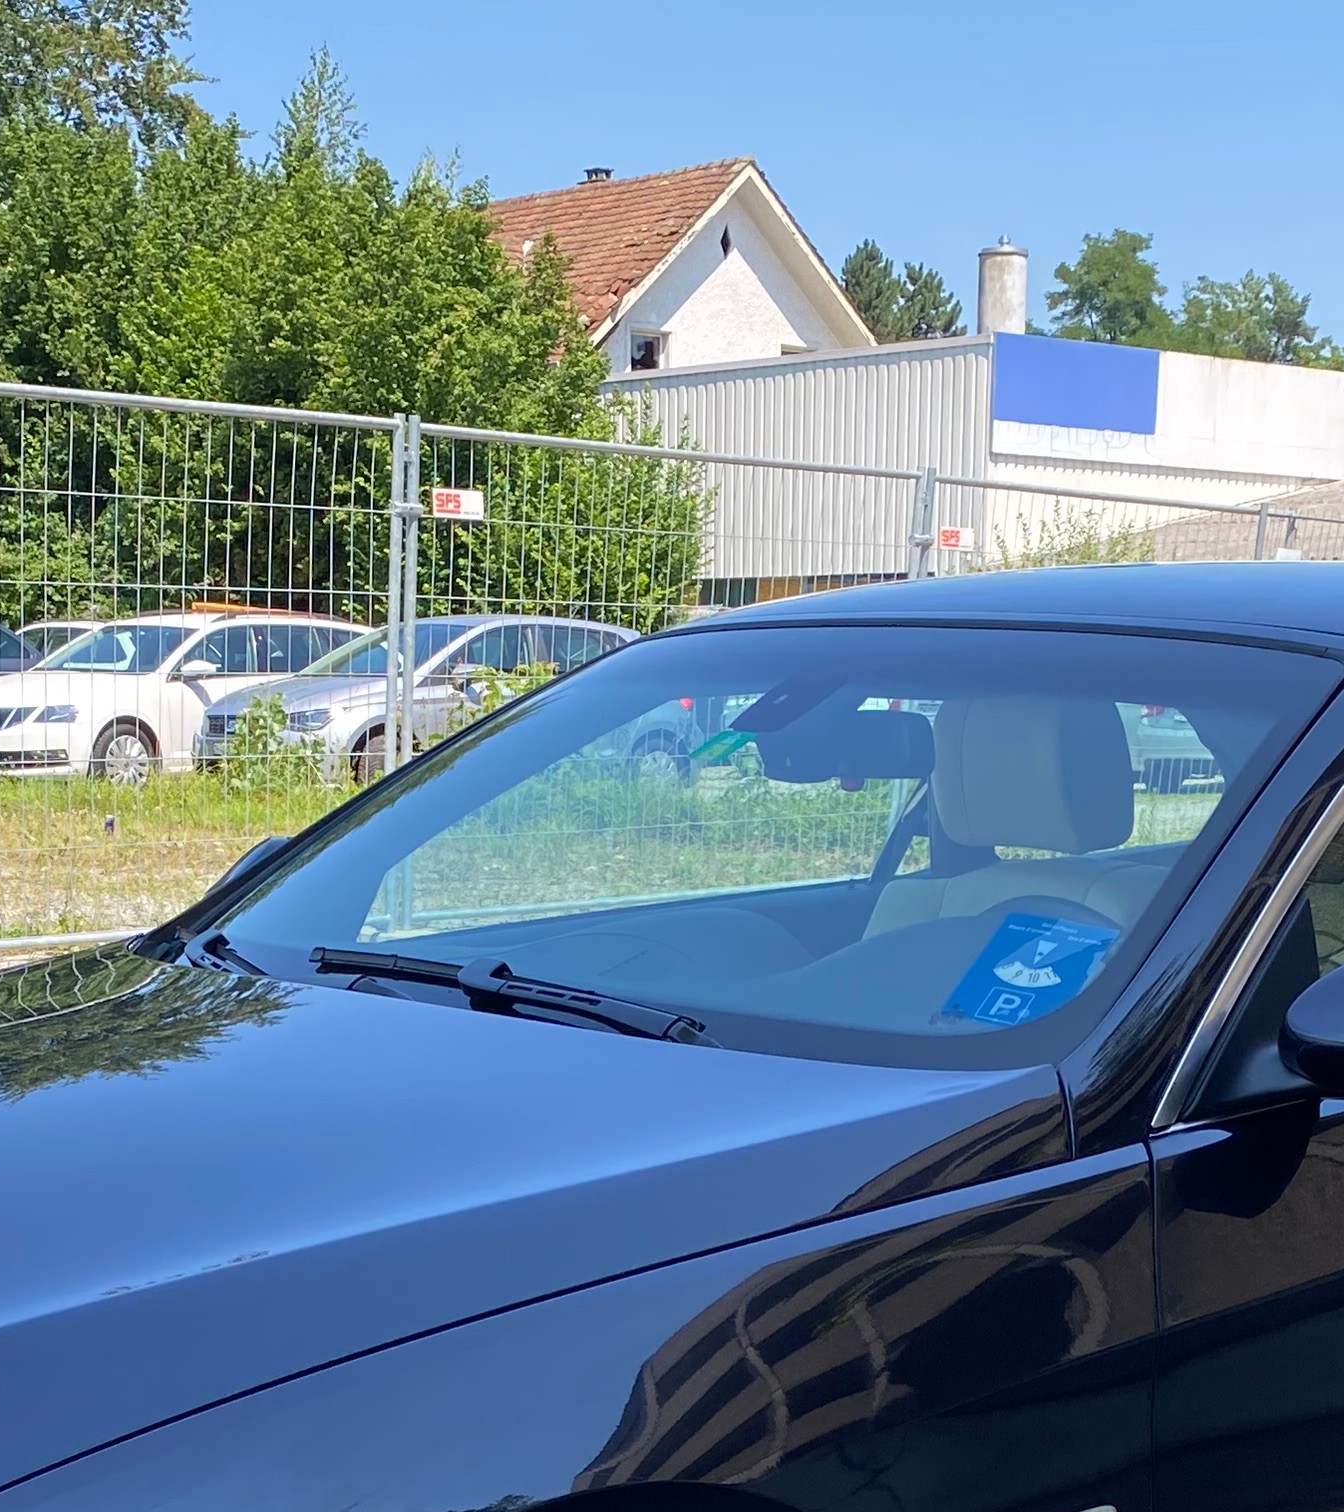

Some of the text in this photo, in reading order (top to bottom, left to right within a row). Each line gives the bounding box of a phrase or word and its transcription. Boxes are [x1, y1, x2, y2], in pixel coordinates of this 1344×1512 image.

[435, 492, 461, 508] SFS
[941, 529, 961, 543] SFS
[1012, 969, 1023, 980] 9
[1028, 973, 1041, 984] 10
[989, 993, 1022, 1016] P
